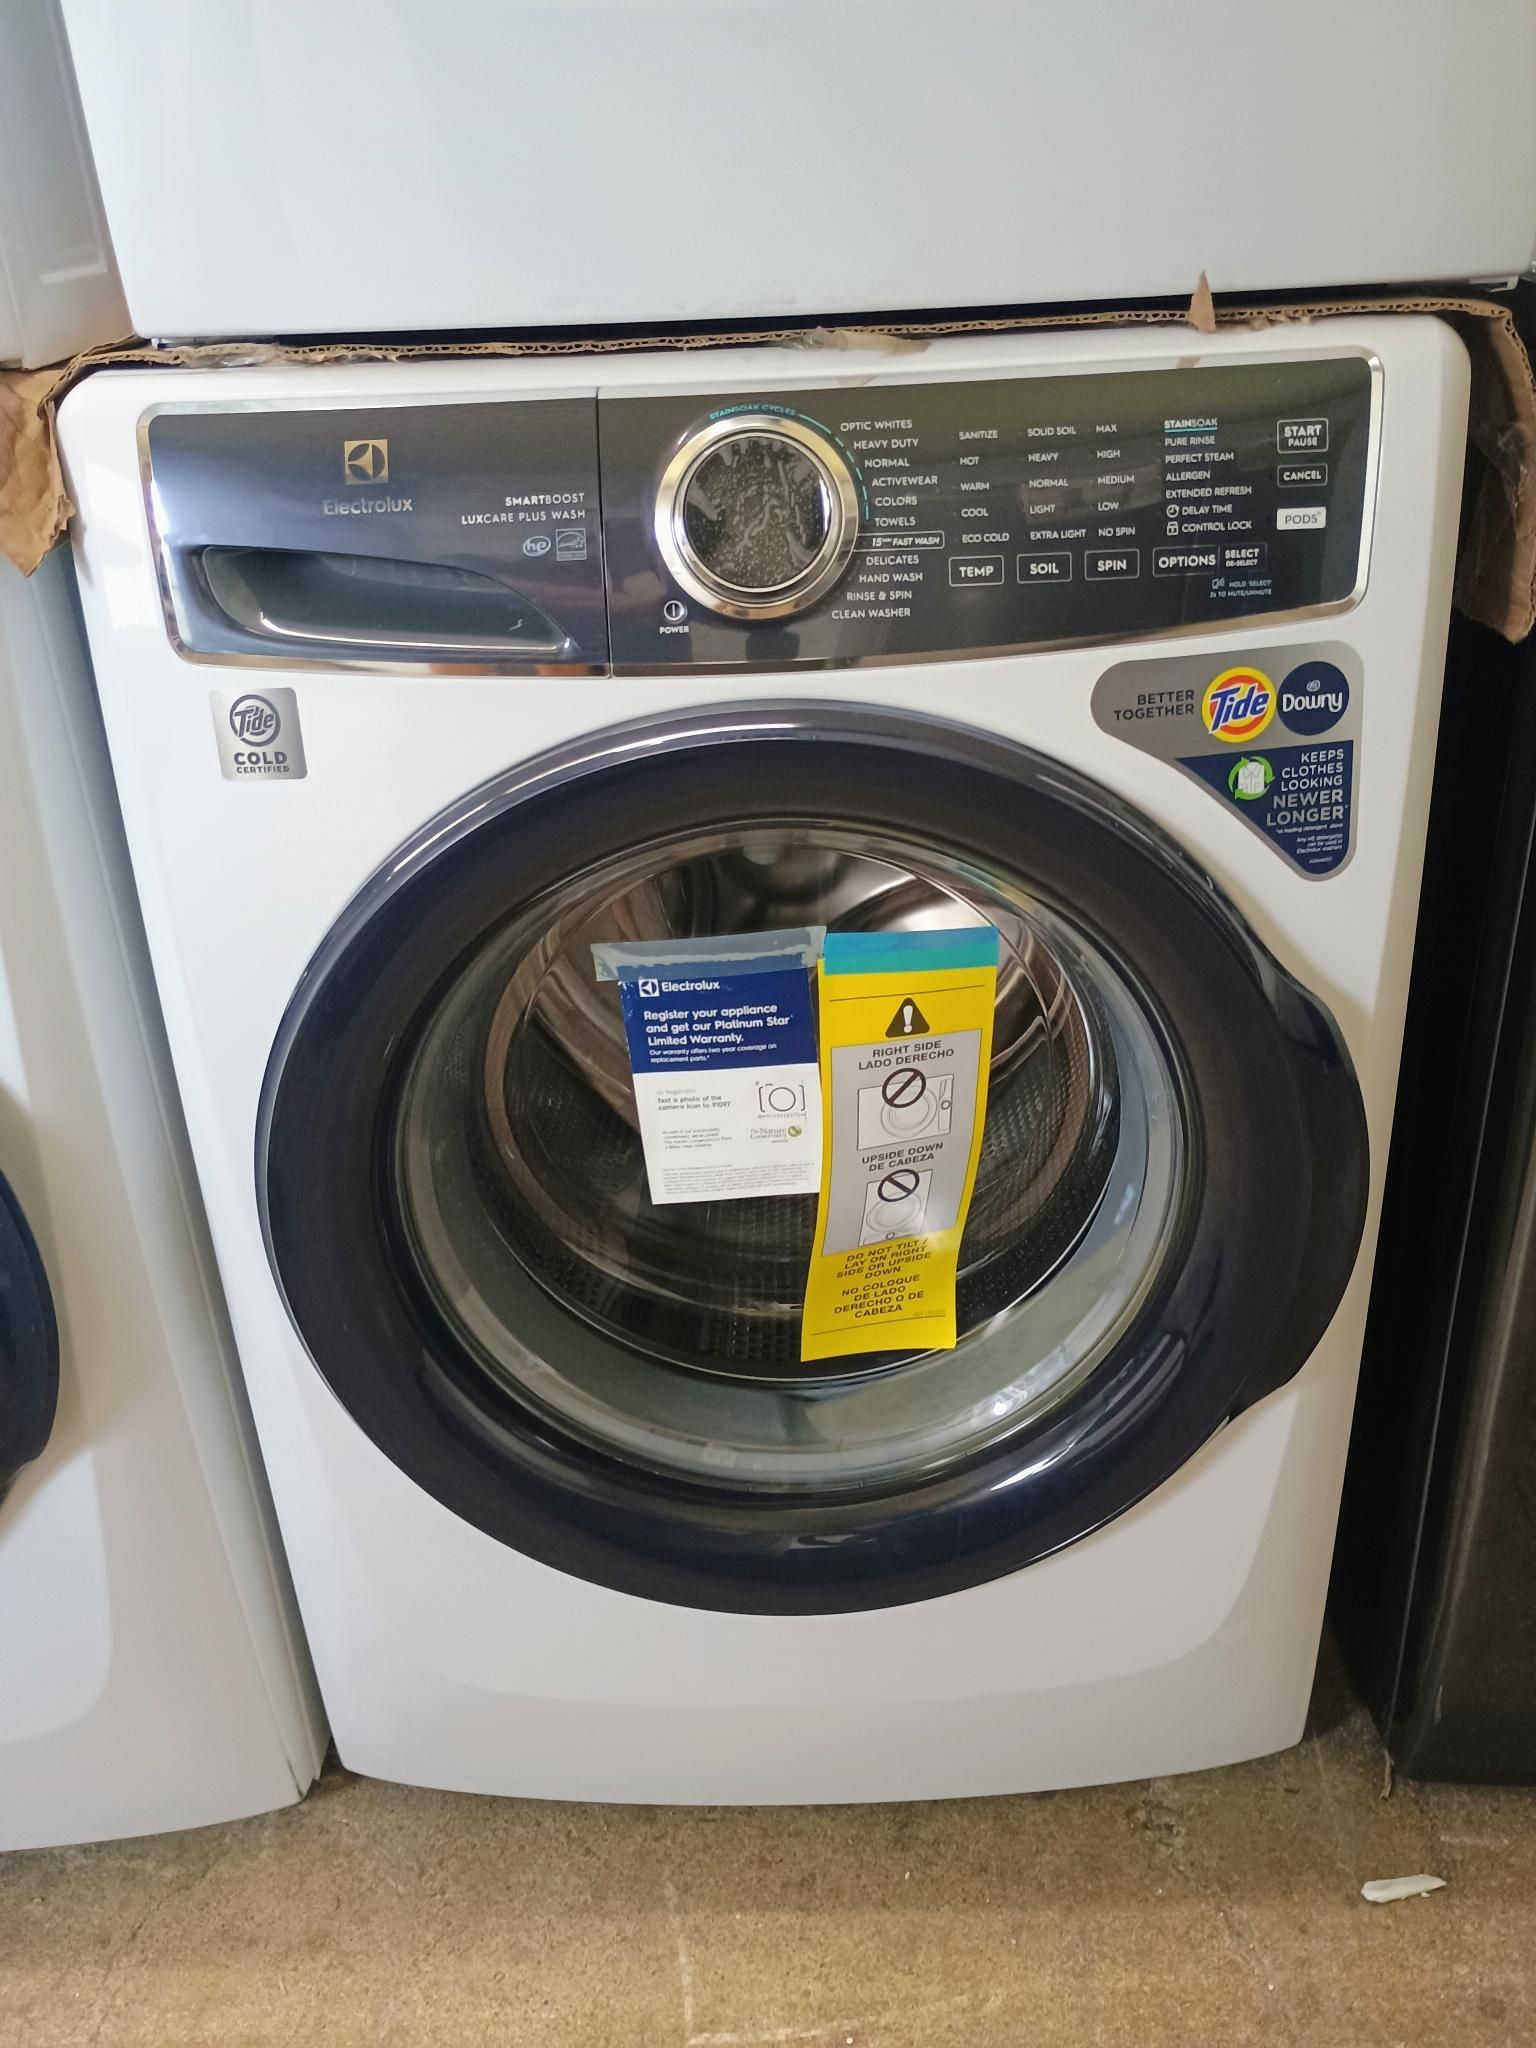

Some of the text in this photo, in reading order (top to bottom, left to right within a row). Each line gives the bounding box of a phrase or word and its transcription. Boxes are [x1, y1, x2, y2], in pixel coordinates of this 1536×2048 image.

[709, 404, 796, 420] STAINSOAK CYCLES
[840, 419, 912, 432] OPTIC WHITES
[1096, 424, 1117, 433] MAX
[1164, 418, 1218, 429] STAINSOAK
[959, 430, 998, 440] SANITIZE
[1028, 426, 1076, 437] SOLID SOIL
[1284, 424, 1321, 438] START
[854, 438, 919, 450] HEAVY DUTY
[1165, 436, 1215, 446] PURE RINSE
[1288, 437, 1317, 447] PAUSE
[1028, 452, 1058, 462] HEAVY
[1097, 449, 1120, 459] HIGH
[1165, 452, 1234, 464] PERFECT STEAM
[864, 458, 910, 468] NORMAL
[960, 456, 979, 465] HOT
[872, 475, 938, 487] ACTIVEWEAR
[1097, 475, 1135, 485] MEDIUM
[1166, 471, 1211, 481] ALLERGEN
[1283, 470, 1321, 481] CANCEL
[960, 482, 990, 491] WARM
[1029, 478, 1068, 488] NORMAL
[1166, 486, 1252, 499] EXTENDED REFRESH
[323, 496, 413, 515] Electrolux
[505, 493, 584, 507] SMARTBOOST
[875, 496, 918, 506] COLORS
[961, 507, 988, 517] COOL
[1030, 504, 1055, 514] LIGHT
[1098, 502, 1119, 511] LOW
[1182, 504, 1233, 516] DELAY TIME
[461, 509, 585, 525] LUXCARE PLUS WASH
[874, 517, 916, 526] TOWELS
[1098, 527, 1135, 537] NO SPIN
[1182, 521, 1252, 533] CONTROL LOCK
[962, 533, 1009, 543] ECO COLD
[1030, 529, 1086, 540] EXTRA LIGHT
[893, 537, 913, 546] FAST
[915, 537, 940, 545] WASH
[1225, 549, 1259, 559] SELECT
[866, 555, 919, 566] DELICATES
[1097, 559, 1126, 572] SPIN
[1159, 554, 1216, 568] OPTIONS
[959, 565, 994, 578] TEMP
[1030, 562, 1059, 574] SOIL
[859, 572, 923, 583] HAND WASH
[847, 590, 912, 601] RINSE & SPIN
[832, 608, 911, 620] CLEAN WASHER
[660, 626, 689, 634] POWER
[1137, 690, 1194, 705] BETTER
[1282, 692, 1342, 712] Downy
[1114, 704, 1195, 721] TOGETHER
[1209, 683, 1269, 734] Tide
[235, 706, 275, 737] Tide
[233, 752, 287, 765] COLD
[1301, 749, 1344, 763] KEEPS
[237, 766, 290, 774] CERTIFIED
[1282, 762, 1343, 778] CLOTHES
[1281, 775, 1343, 791] LOOKING
[1273, 789, 1343, 809] NEWER
[661, 980, 720, 992] Electrolux
[644, 1004, 777, 1022] Register your appliance
[646, 1024, 668, 1033] and
[671, 1023, 689, 1034] get
[693, 1023, 711, 1031] our
[715, 1019, 763, 1030] Platinum
[648, 1033, 744, 1046] Limited Warranty.
[721, 1046, 736, 1054] year
[737, 1044, 767, 1052] coverage
[872, 1040, 941, 1058] RIGHT SIDE
[651, 1056, 688, 1064] replacement
[859, 1049, 954, 1070] LADO DERECHO
[862, 1142, 943, 1164] UPSIDE DOWN
[889, 1153, 934, 1168] CABEZA
[847, 1253, 864, 1261] DO
[868, 1246, 892, 1256] NOT
[897, 1239, 918, 1249] TILT
[845, 1246, 926, 1269] LAY ON RIGHT
[837, 1252, 932, 1278] SIDE OR UPSIDE
[865, 1266, 901, 1279] DOWN
[842, 1274, 920, 1296] NO COLOQUE
[854, 1286, 905, 1301] DE LADO
[834, 1296, 891, 1314] DERECHO
[908, 1290, 924, 1300] DE
[855, 1304, 902, 1318] CABEZA
